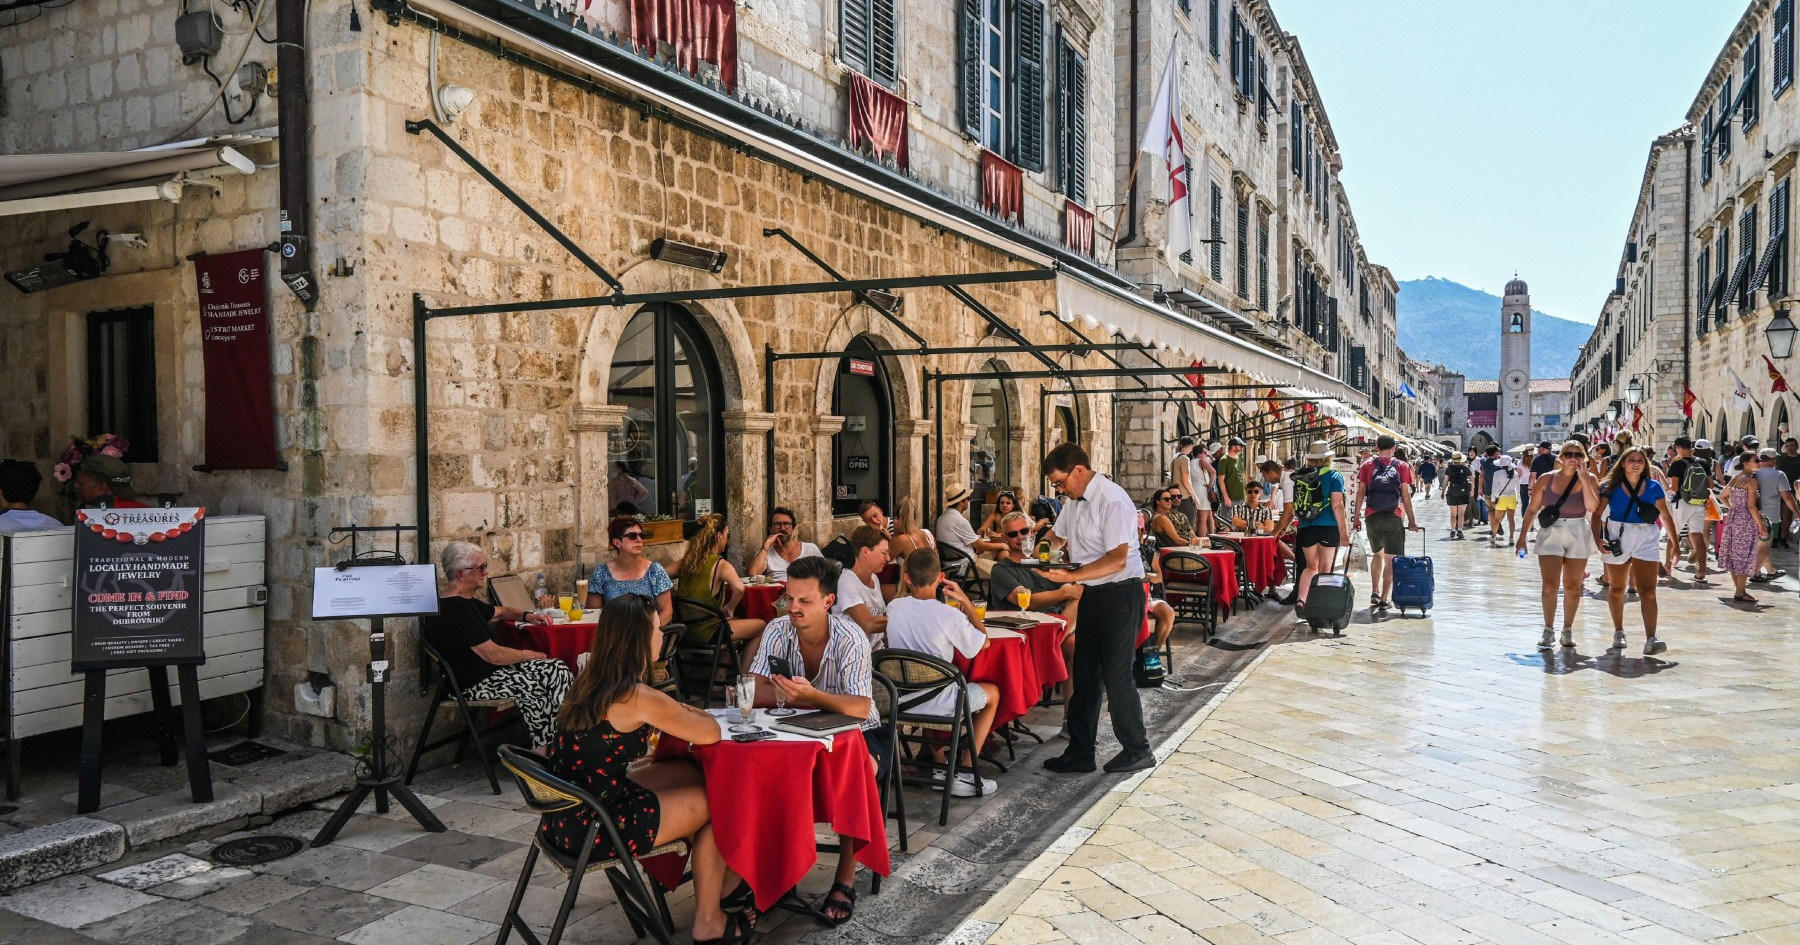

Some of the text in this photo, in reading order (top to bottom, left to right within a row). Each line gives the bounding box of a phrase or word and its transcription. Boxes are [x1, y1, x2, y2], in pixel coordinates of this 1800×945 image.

[232, 324, 255, 332] MARKET
[849, 461, 868, 469] OPEN
[122, 515, 180, 523] TREASURES
[89, 562, 189, 572] LOCALLY HANDMADE
[118, 571, 161, 580] JEWELRY
[88, 590, 189, 603] COME IN & FIND
[112, 617, 164, 625] DUBROVNIK!
